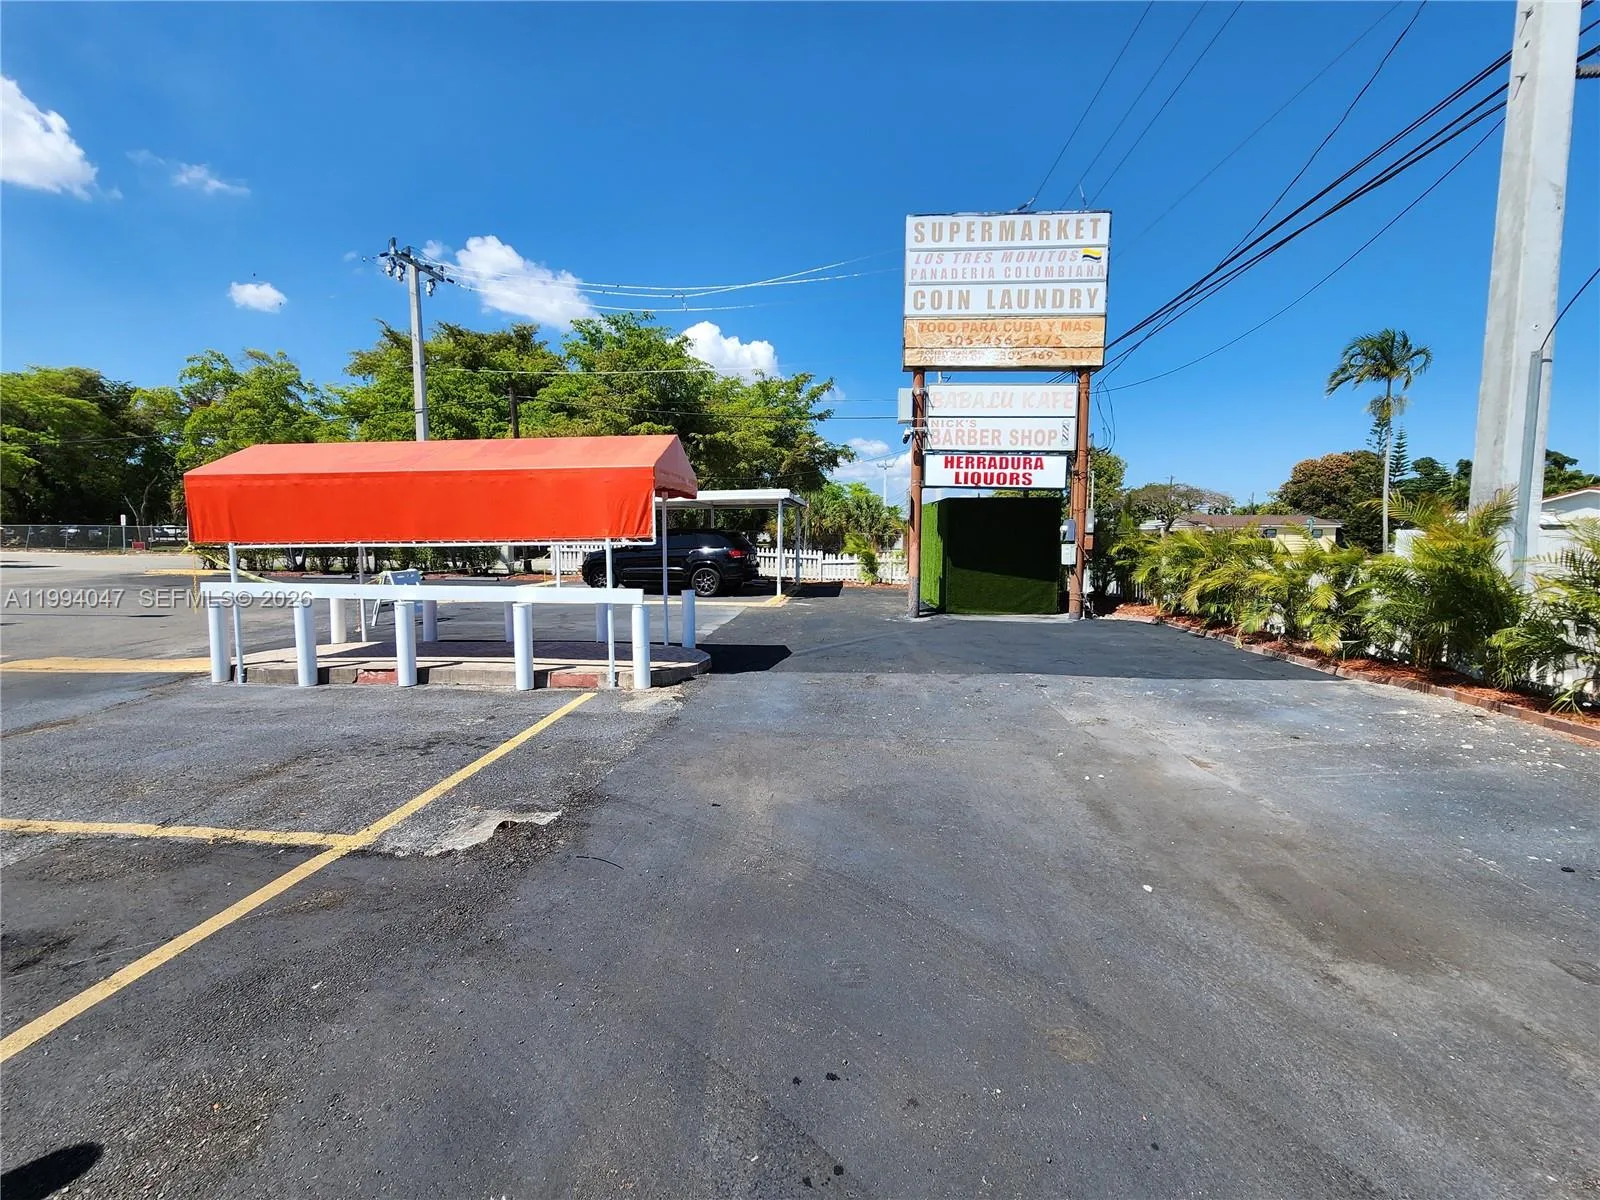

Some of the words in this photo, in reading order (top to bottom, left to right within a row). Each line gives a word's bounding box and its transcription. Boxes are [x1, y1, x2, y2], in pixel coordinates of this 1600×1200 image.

[913, 218, 1101, 243] SUPERMARKET
[914, 252, 945, 265] LOS
[953, 251, 993, 264] TRES
[1001, 250, 1078, 263] MONITOS
[911, 267, 995, 280] PANADERIA
[1004, 265, 1105, 279] COLOMBIANA
[913, 289, 971, 311] COIN
[987, 288, 1099, 310] LAUNDRY
[918, 322, 959, 333] TODO
[962, 321, 998, 333] PARA
[1002, 321, 1042, 332] CUBA
[1047, 321, 1056, 332] Y
[1061, 321, 1092, 332] MAS
[931, 391, 1014, 409] BABALU
[1022, 391, 1074, 409] KAFE
[931, 419, 977, 428] NICK'S
[930, 429, 1002, 446] BARBER
[1008, 429, 1058, 446] SHOP
[944, 455, 1044, 470] HERRADURA
[954, 472, 1033, 487] LIQUORS
